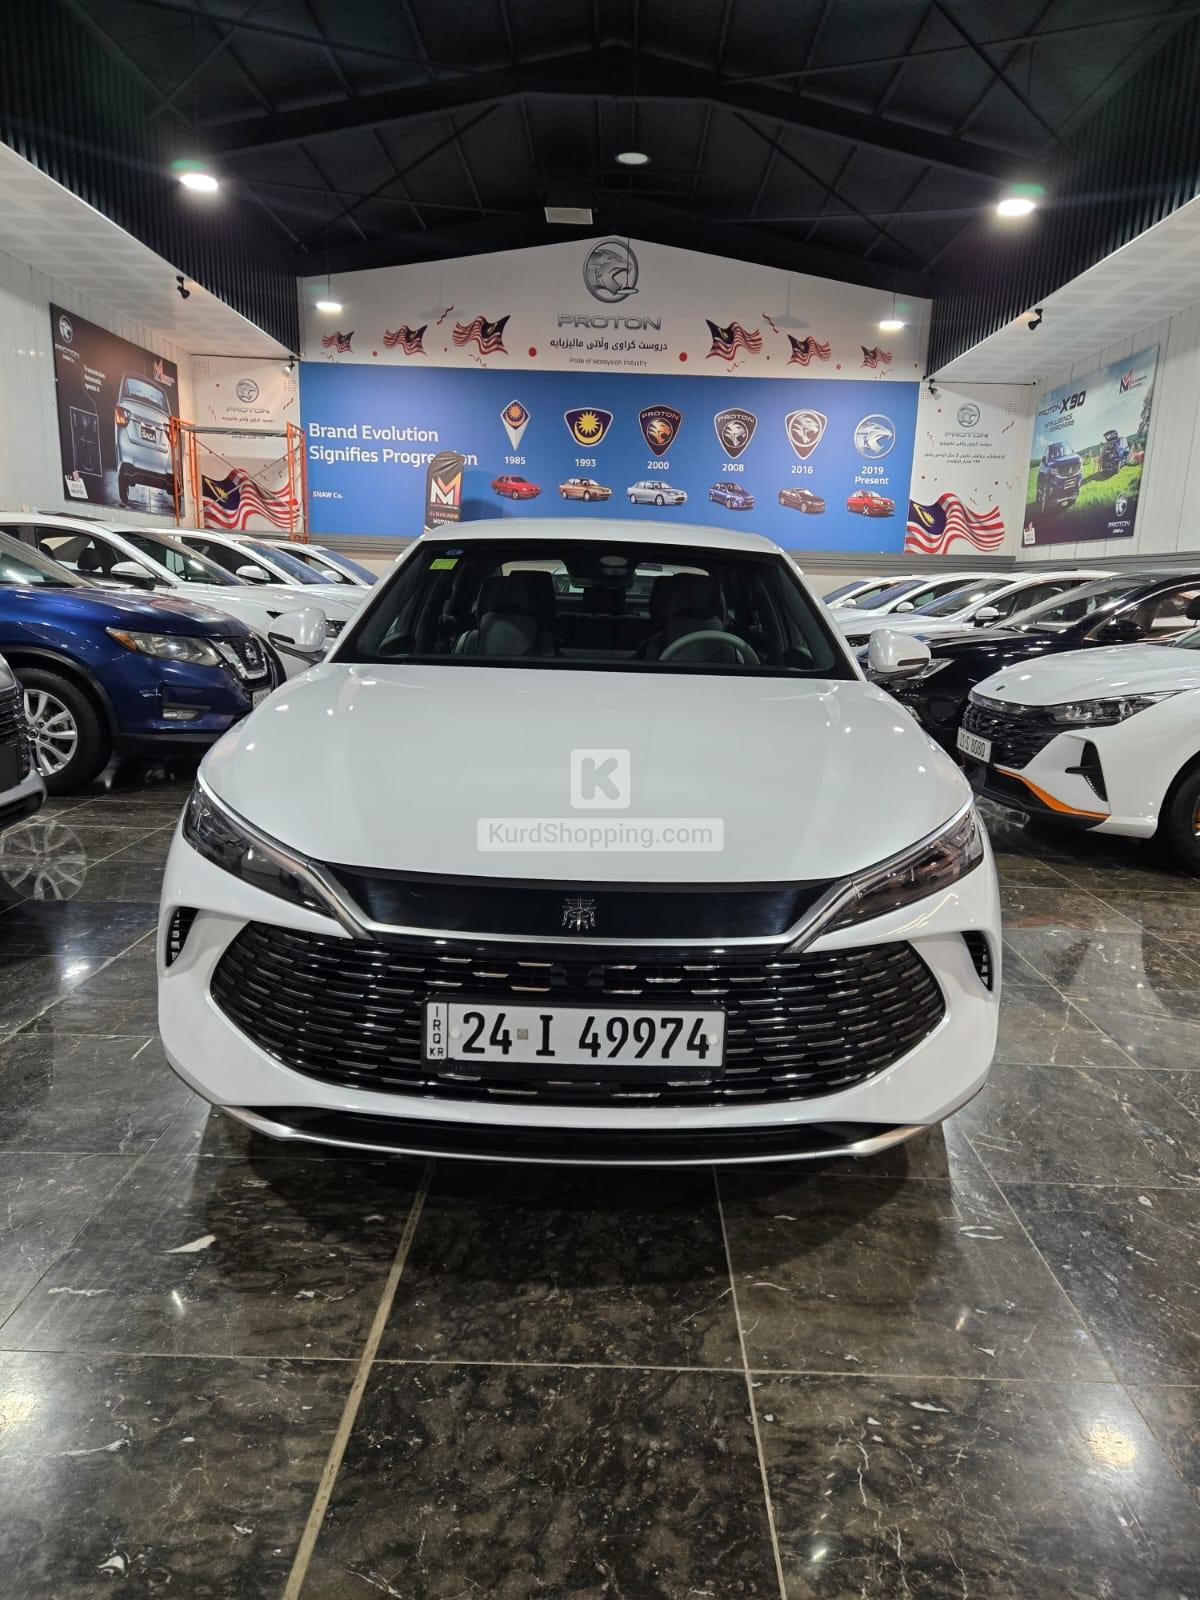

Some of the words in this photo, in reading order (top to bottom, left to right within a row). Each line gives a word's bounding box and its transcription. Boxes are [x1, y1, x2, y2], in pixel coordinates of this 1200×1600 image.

[557, 313, 662, 330] PROTON
[569, 356, 585, 364] Pride
[593, 358, 622, 366] Malaysian
[623, 359, 647, 367] Industry
[1038, 403, 1062, 417] PROTON
[1060, 390, 1087, 414] X90
[641, 410, 680, 421] PROTON
[717, 413, 755, 424] PROTON
[308, 422, 357, 439] Brand
[362, 425, 439, 442] Evolution
[309, 445, 378, 464] Signifies
[504, 456, 526, 465] 1985
[575, 458, 597, 467] 1993
[647, 461, 669, 470] 2000
[722, 463, 744, 472] 2008
[791, 465, 813, 474] 2016
[861, 466, 884, 474] 2019
[854, 476, 890, 485] Present
[1107, 520, 1130, 528] PROTON
[462, 1011, 512, 1055] 24
[535, 1014, 556, 1057] I
[578, 1015, 710, 1059] 49974
[430, 1047, 444, 1056] KR
